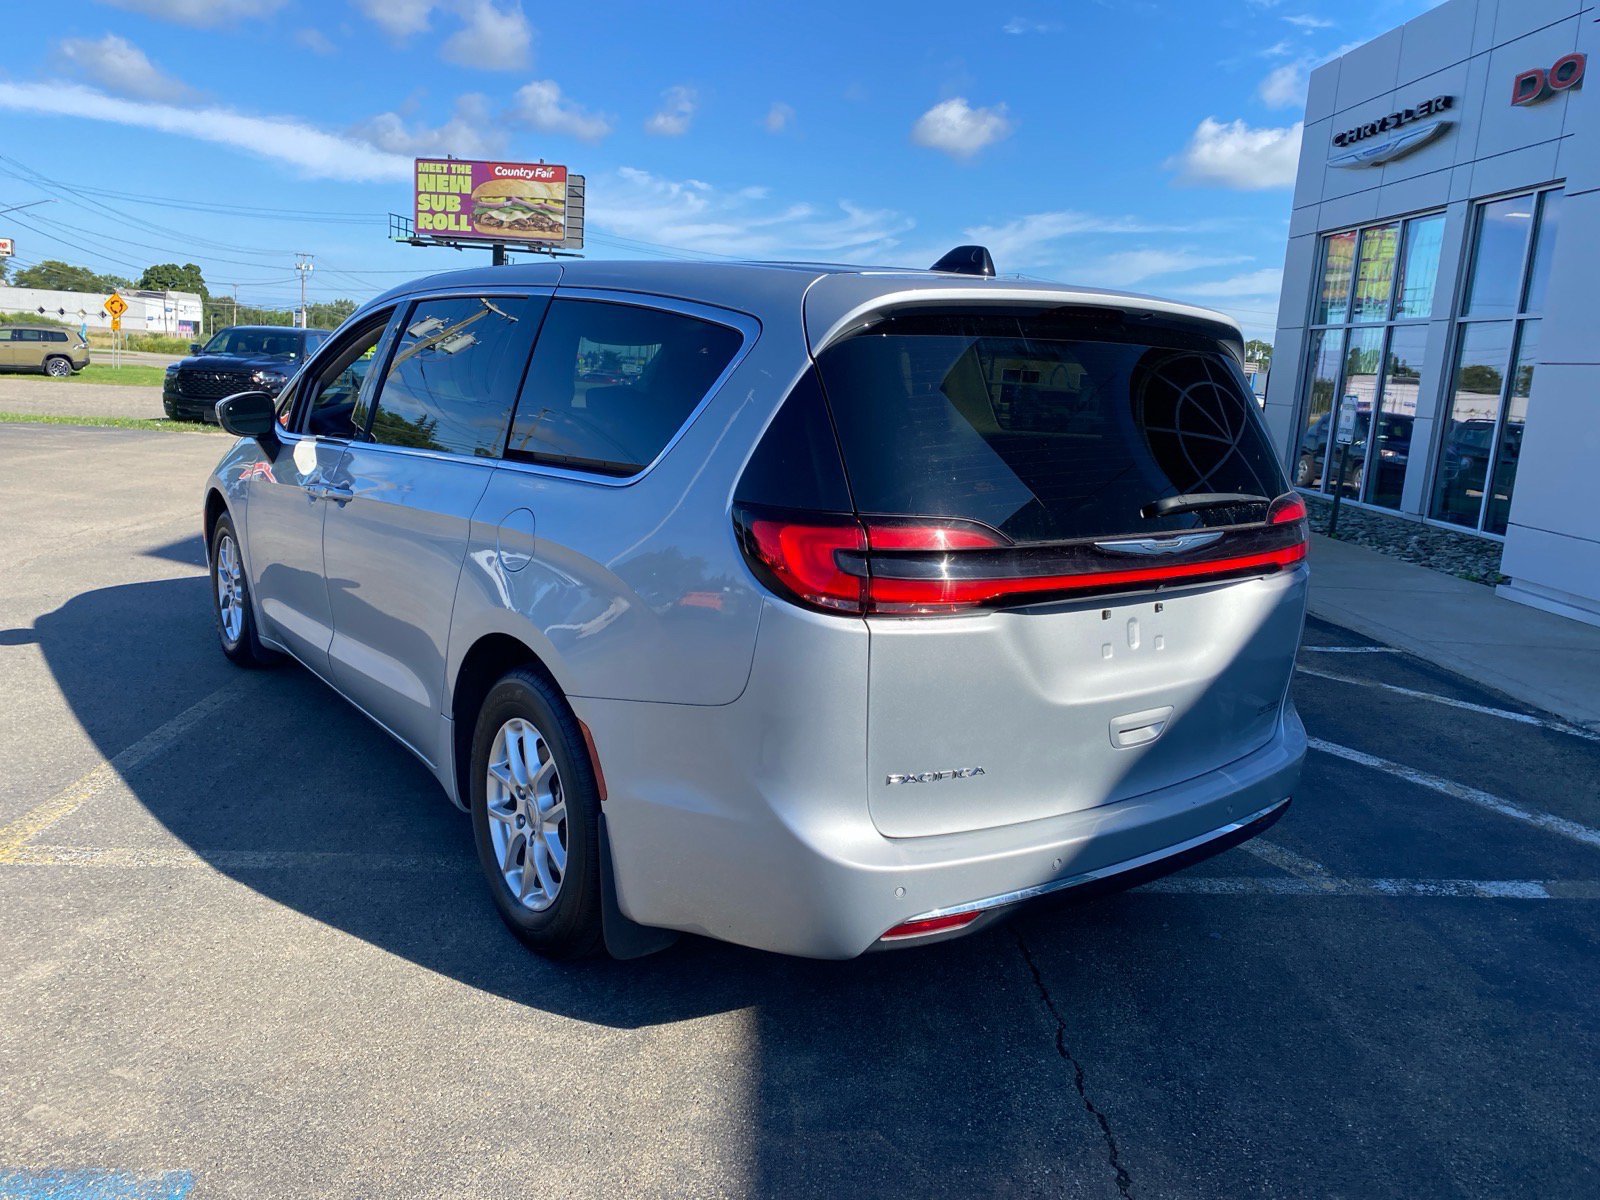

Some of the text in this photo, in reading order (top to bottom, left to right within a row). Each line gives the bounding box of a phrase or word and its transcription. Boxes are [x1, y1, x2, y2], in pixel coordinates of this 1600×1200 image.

[1333, 95, 1453, 147] CHRYSLER
[418, 163, 472, 174] MEET THE
[494, 166, 555, 179] Country Fair
[418, 174, 472, 194] NEW
[418, 194, 461, 212] SUB
[418, 213, 472, 232] ROLL
[886, 766, 986, 786] PACIFICA
